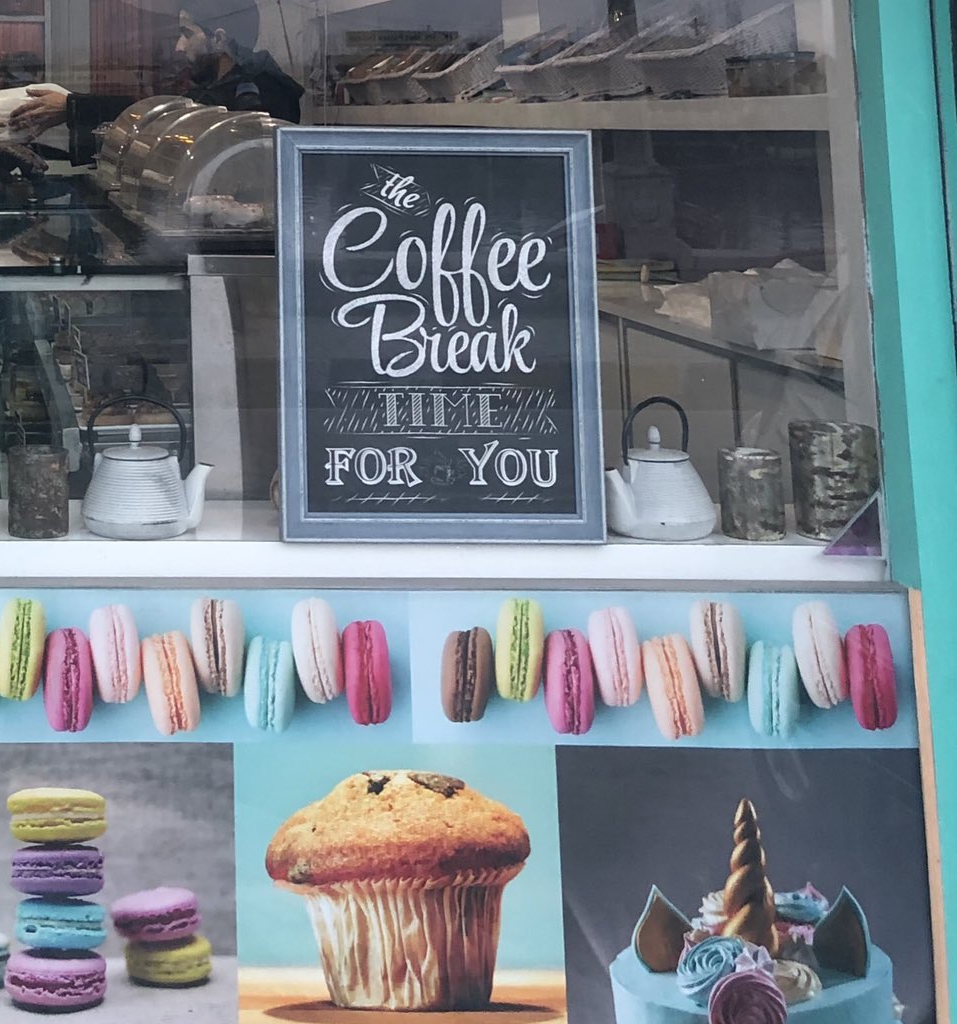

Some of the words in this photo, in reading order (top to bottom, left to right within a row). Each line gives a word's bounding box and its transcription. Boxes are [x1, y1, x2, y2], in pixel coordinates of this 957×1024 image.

[380, 173, 421, 209] the
[322, 202, 551, 327] Coffee
[337, 293, 537, 377] Break
[378, 391, 504, 429] TIME
[324, 446, 423, 488] FOR
[458, 440, 560, 488] YOU
